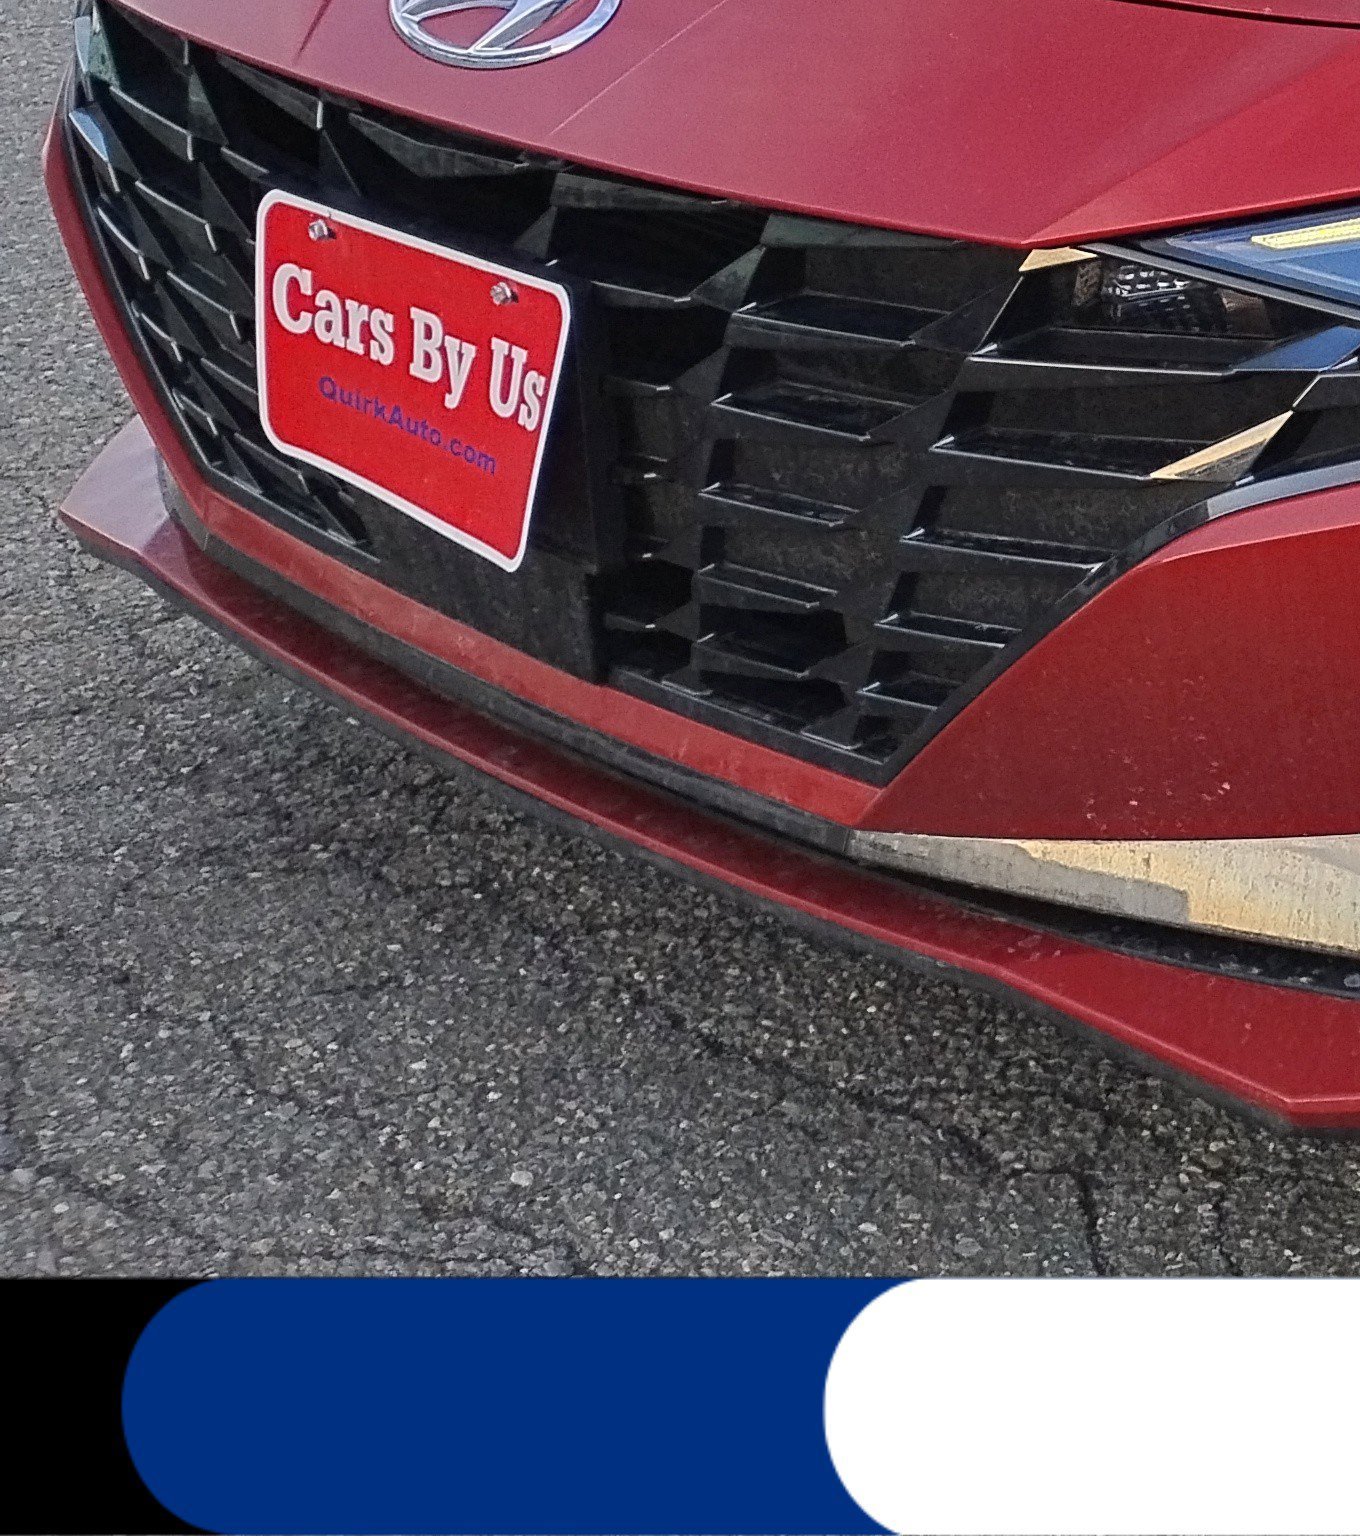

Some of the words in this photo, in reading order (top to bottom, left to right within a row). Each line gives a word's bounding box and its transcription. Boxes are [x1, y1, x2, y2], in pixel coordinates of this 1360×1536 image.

[272, 262, 395, 366] Cars
[408, 305, 477, 410] By
[489, 336, 547, 433] Us
[317, 375, 498, 476] QuirkAuto.com
